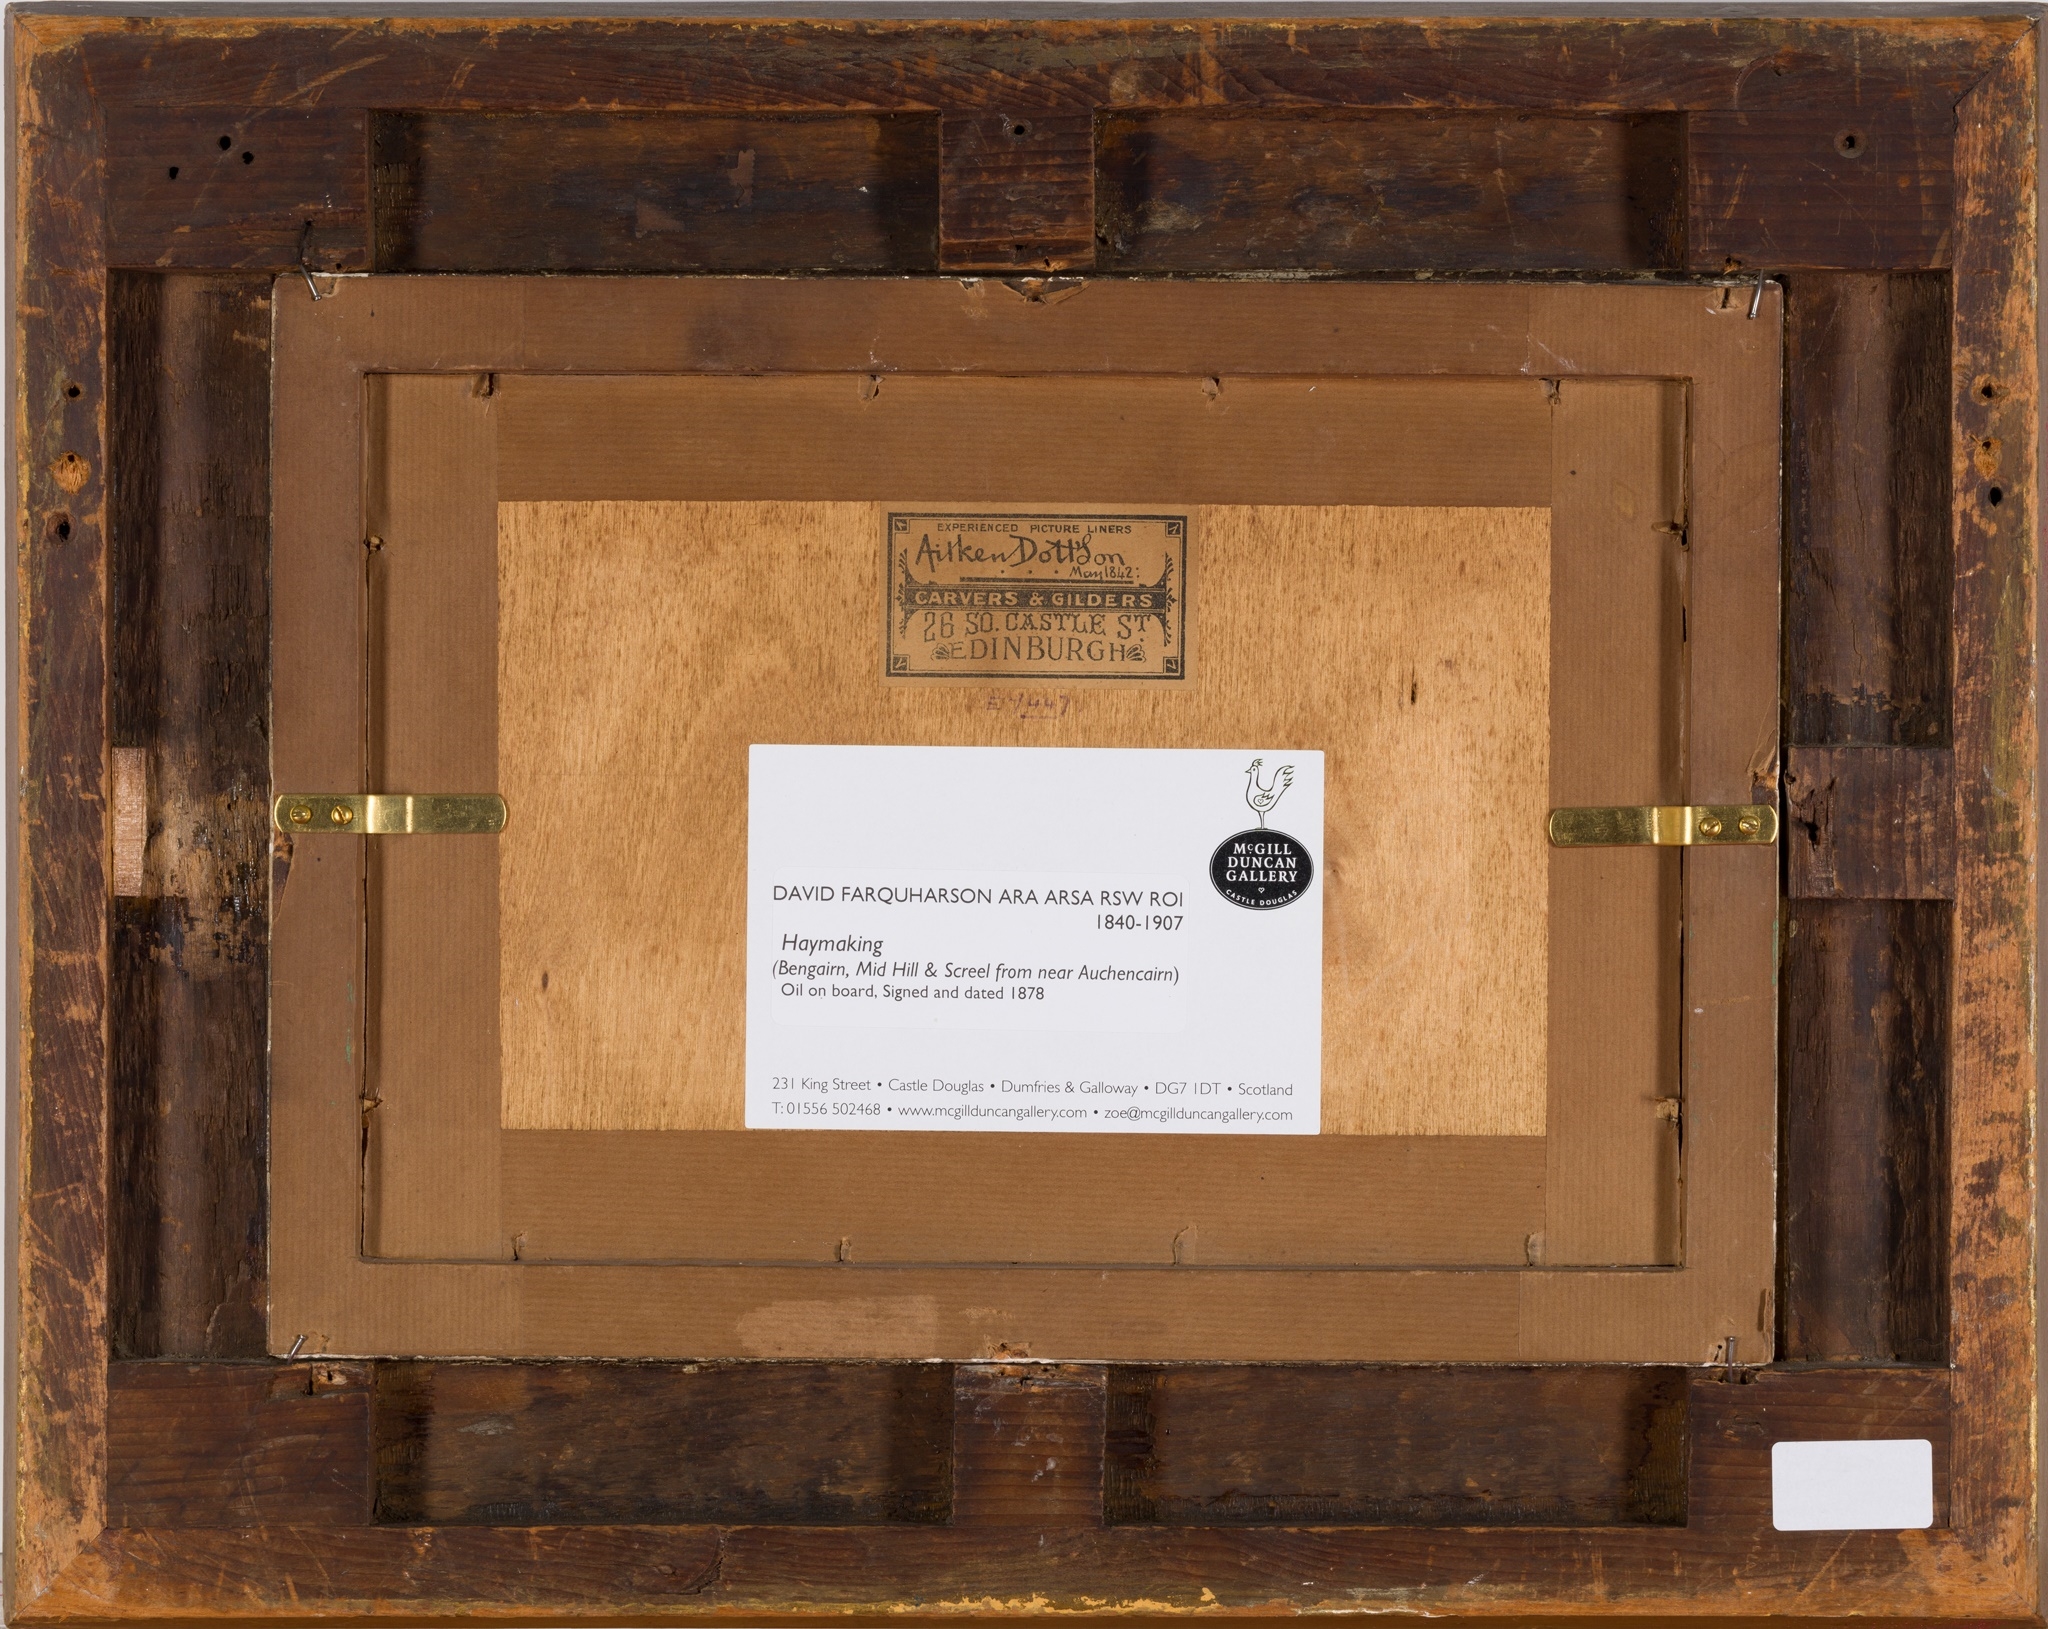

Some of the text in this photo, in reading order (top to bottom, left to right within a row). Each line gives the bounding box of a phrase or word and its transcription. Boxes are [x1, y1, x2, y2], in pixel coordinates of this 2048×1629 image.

[937, 523, 1132, 535] EXPERIENCED PICTURE LINERS
[915, 533, 1008, 573] Aitken
[915, 591, 1152, 608] CARVERS & GILDERS
[923, 612, 955, 642] 26
[1005, 612, 1106, 636] CASTLE
[949, 635, 1127, 661] EDINBURGH
[1227, 856, 1297, 869] DUNCAN
[1225, 869, 1298, 883] GALLERY
[774, 886, 1182, 907] DAVID FARQUHARSON ARA ARSA RSW ROI
[1225, 889, 1298, 906] CASTLE DOUGLAS
[1098, 914, 1183, 930] 1840-1907
[782, 934, 883, 957] Haymaking
[773, 960, 1178, 985] (Bengairn, Mid Hill & Screel from near Auchencairn)
[781, 983, 1044, 1001] Oil on board, Signed and dated 1878
[773, 1077, 1292, 1097] 231 King Street Castle Douglas Dumfries & Galloway DG7 1DT Scotland
[833, 1103, 881, 1115] 502468
[898, 1105, 1087, 1121] www.mcgillduncangallery.com
[1105, 1106, 1292, 1123] zoe@mcgillduncangallery.com
